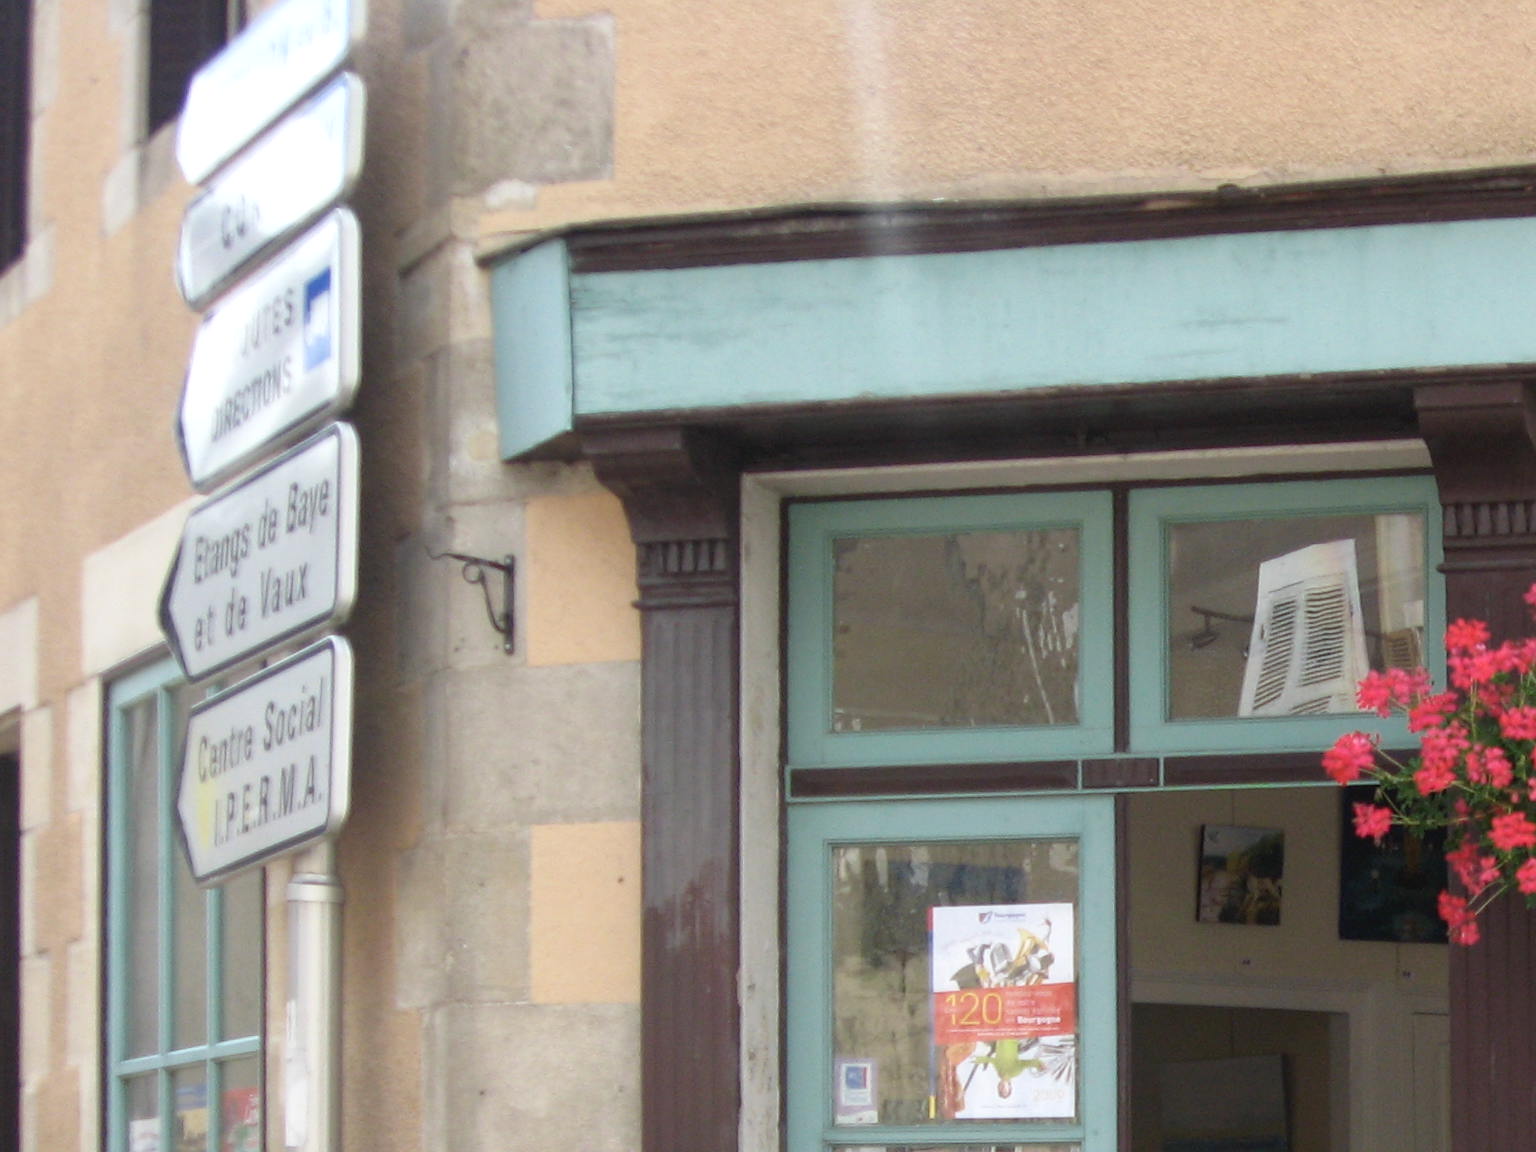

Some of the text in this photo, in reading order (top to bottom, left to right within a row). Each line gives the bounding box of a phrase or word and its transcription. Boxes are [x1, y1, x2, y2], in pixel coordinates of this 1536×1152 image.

[257, 498, 278, 548] de
[285, 477, 331, 536] Baye
[193, 561, 311, 653] et de Vaux
[199, 677, 326, 785] Centre Social
[945, 991, 1003, 1026] 120
